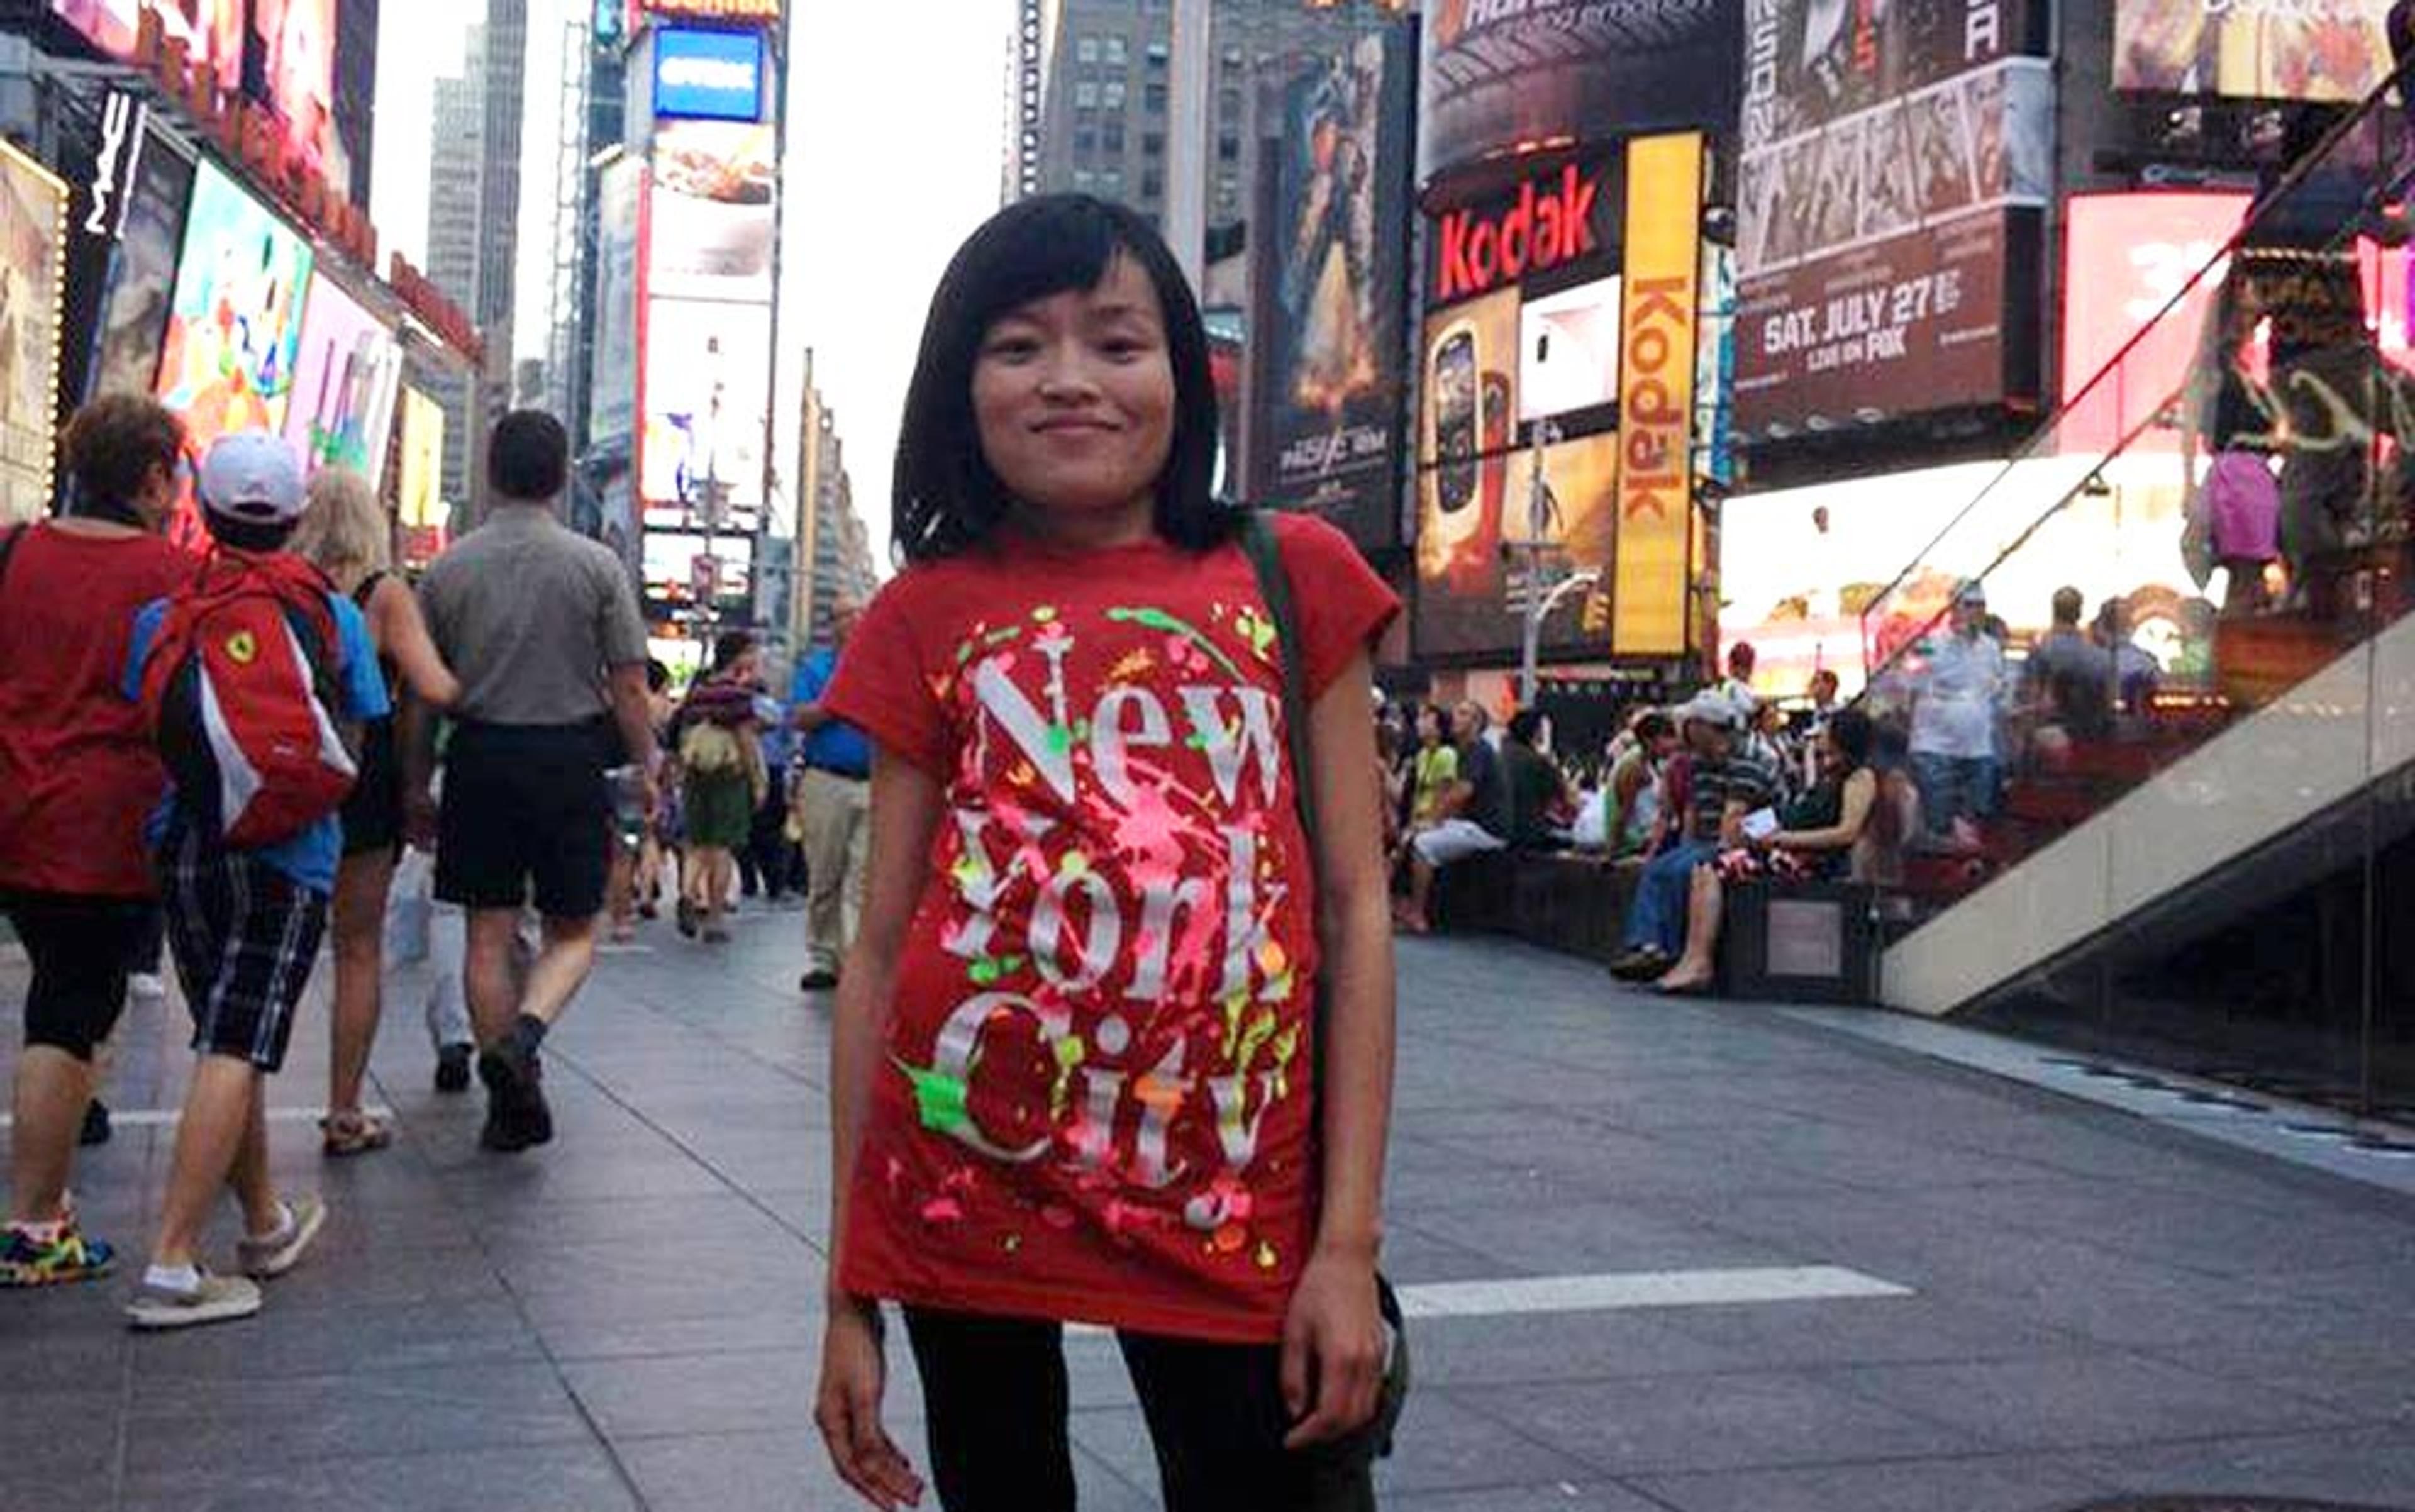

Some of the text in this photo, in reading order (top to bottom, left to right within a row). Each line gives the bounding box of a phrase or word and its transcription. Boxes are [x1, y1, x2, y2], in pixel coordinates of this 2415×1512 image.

[1438, 164, 1597, 298] Kodak
[1764, 308, 1816, 353] SAT.
[1822, 287, 1887, 342] JULY
[1893, 276, 1931, 323] 27
[1624, 277, 1687, 519] Kodak
[962, 636, 1281, 806] New
[941, 808, 1292, 1003] York
[931, 992, 1284, 1228] City
